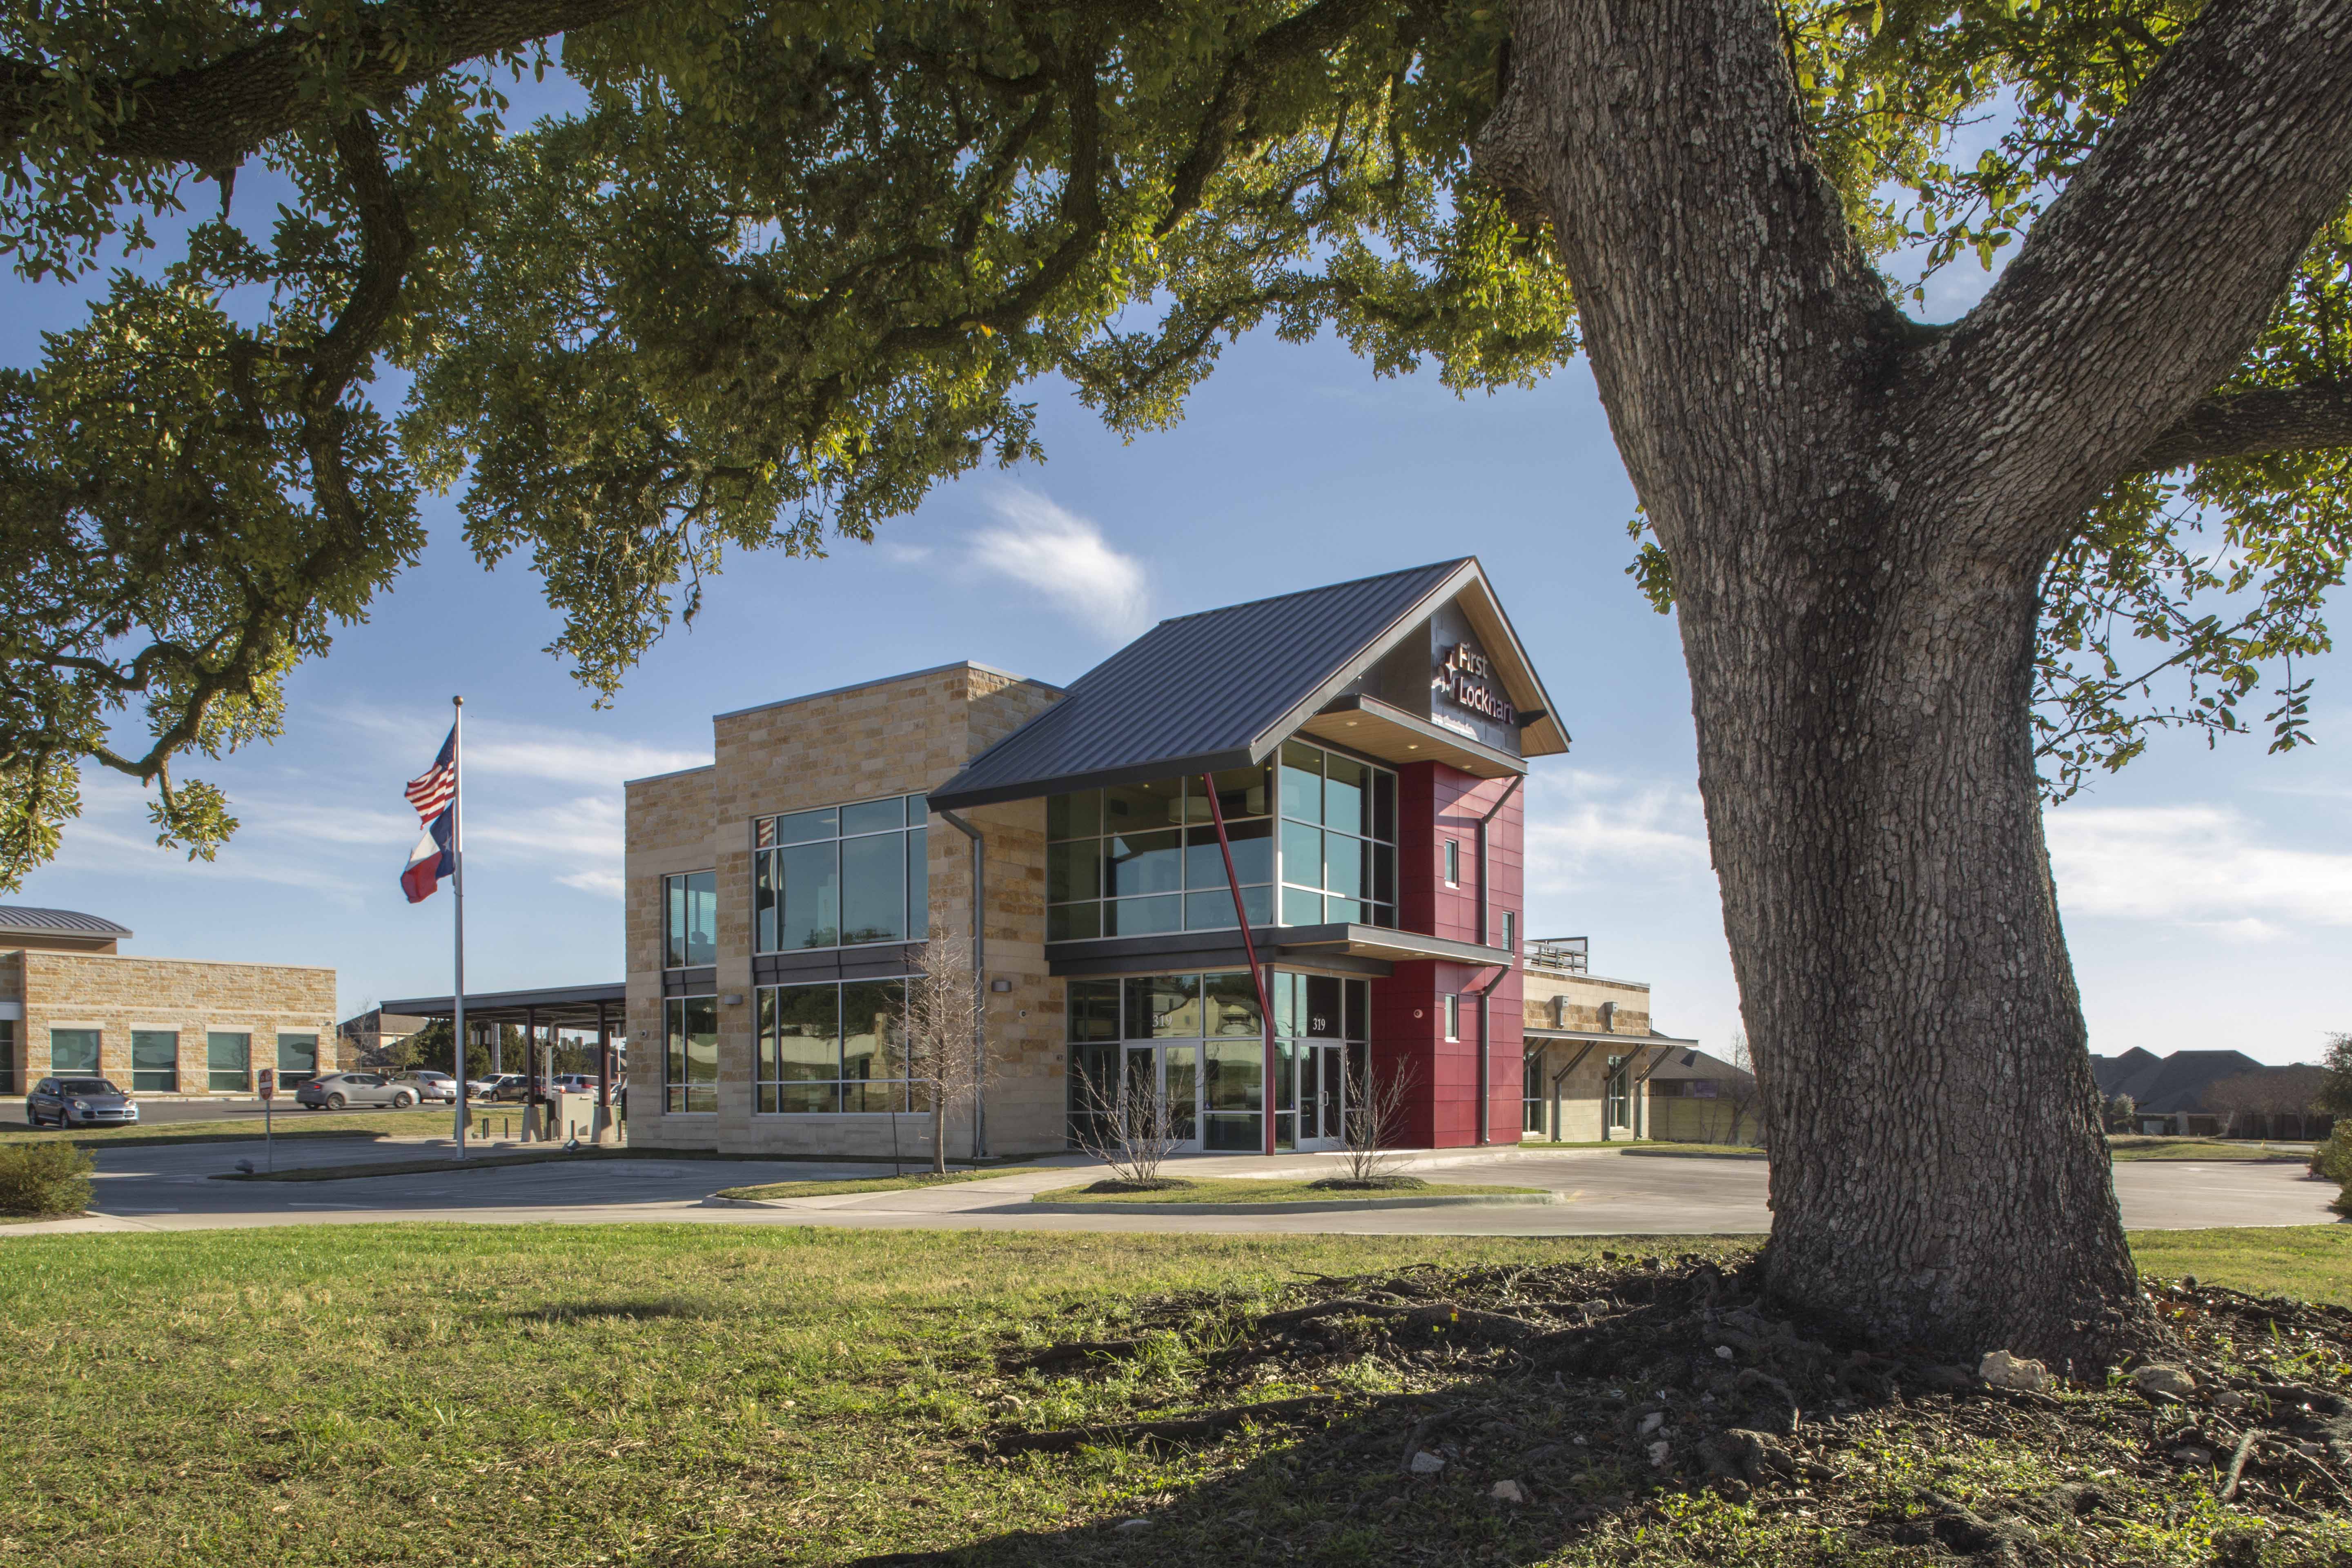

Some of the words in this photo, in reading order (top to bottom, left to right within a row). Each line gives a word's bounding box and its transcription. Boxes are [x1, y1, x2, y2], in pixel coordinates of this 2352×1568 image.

[1459, 643, 1488, 679] First
[1460, 676, 1514, 725] Lockhart
[1152, 1015, 1173, 1027] 319
[1313, 1018, 1325, 1031] 319
